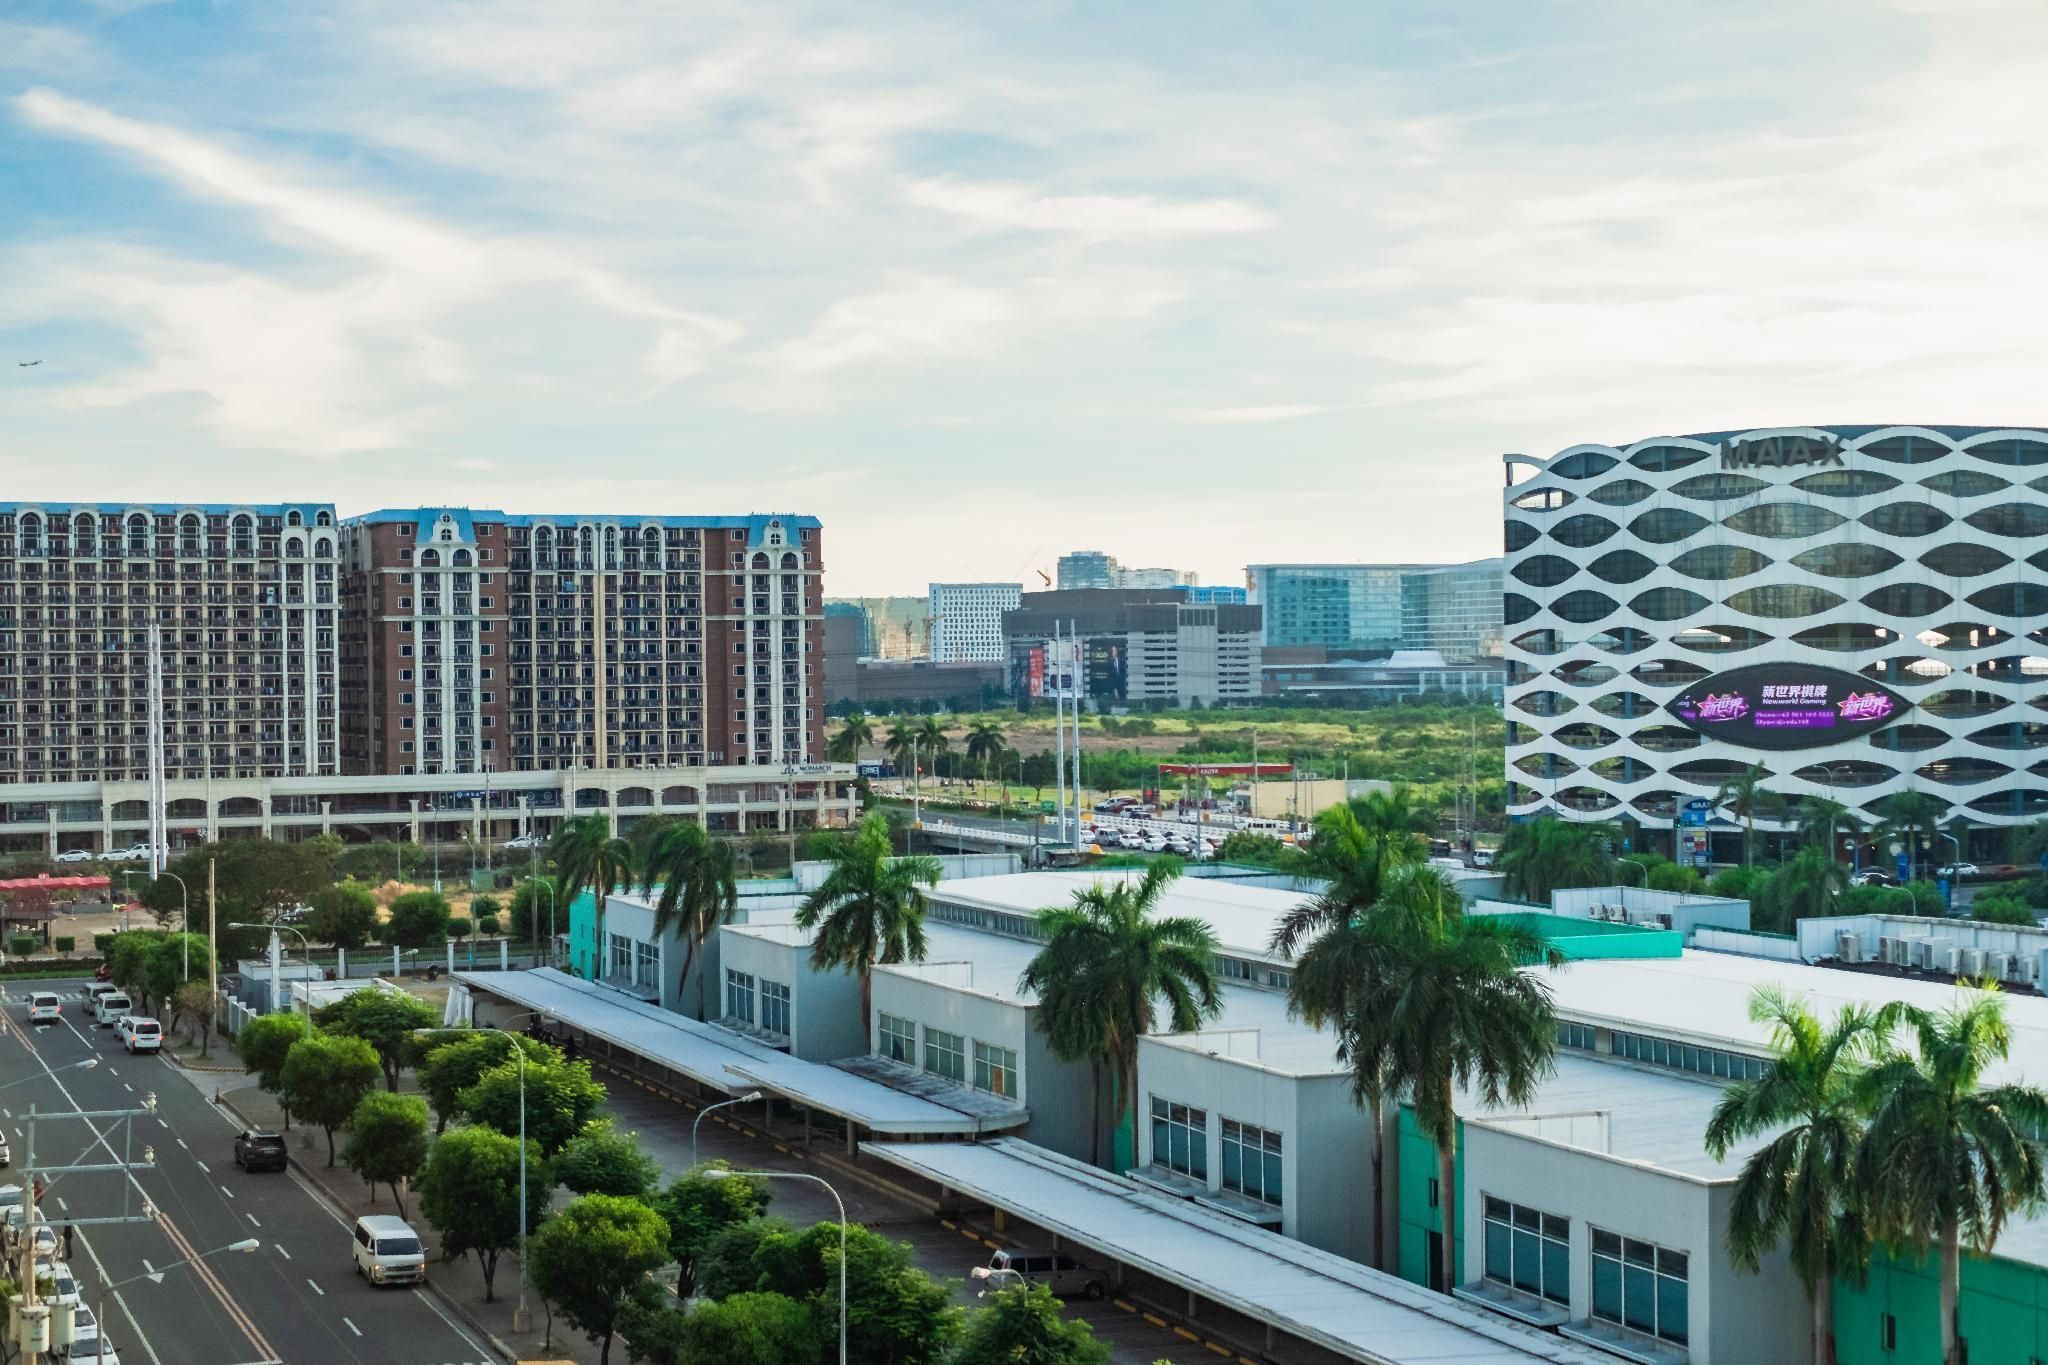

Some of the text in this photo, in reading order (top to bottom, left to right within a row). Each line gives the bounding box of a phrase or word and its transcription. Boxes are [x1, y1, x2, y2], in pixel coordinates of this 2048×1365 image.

[1721, 436, 1845, 469] MAAX
[1761, 684, 1828, 698] 新世界棋牌
[1799, 698, 1827, 706] Gaming
